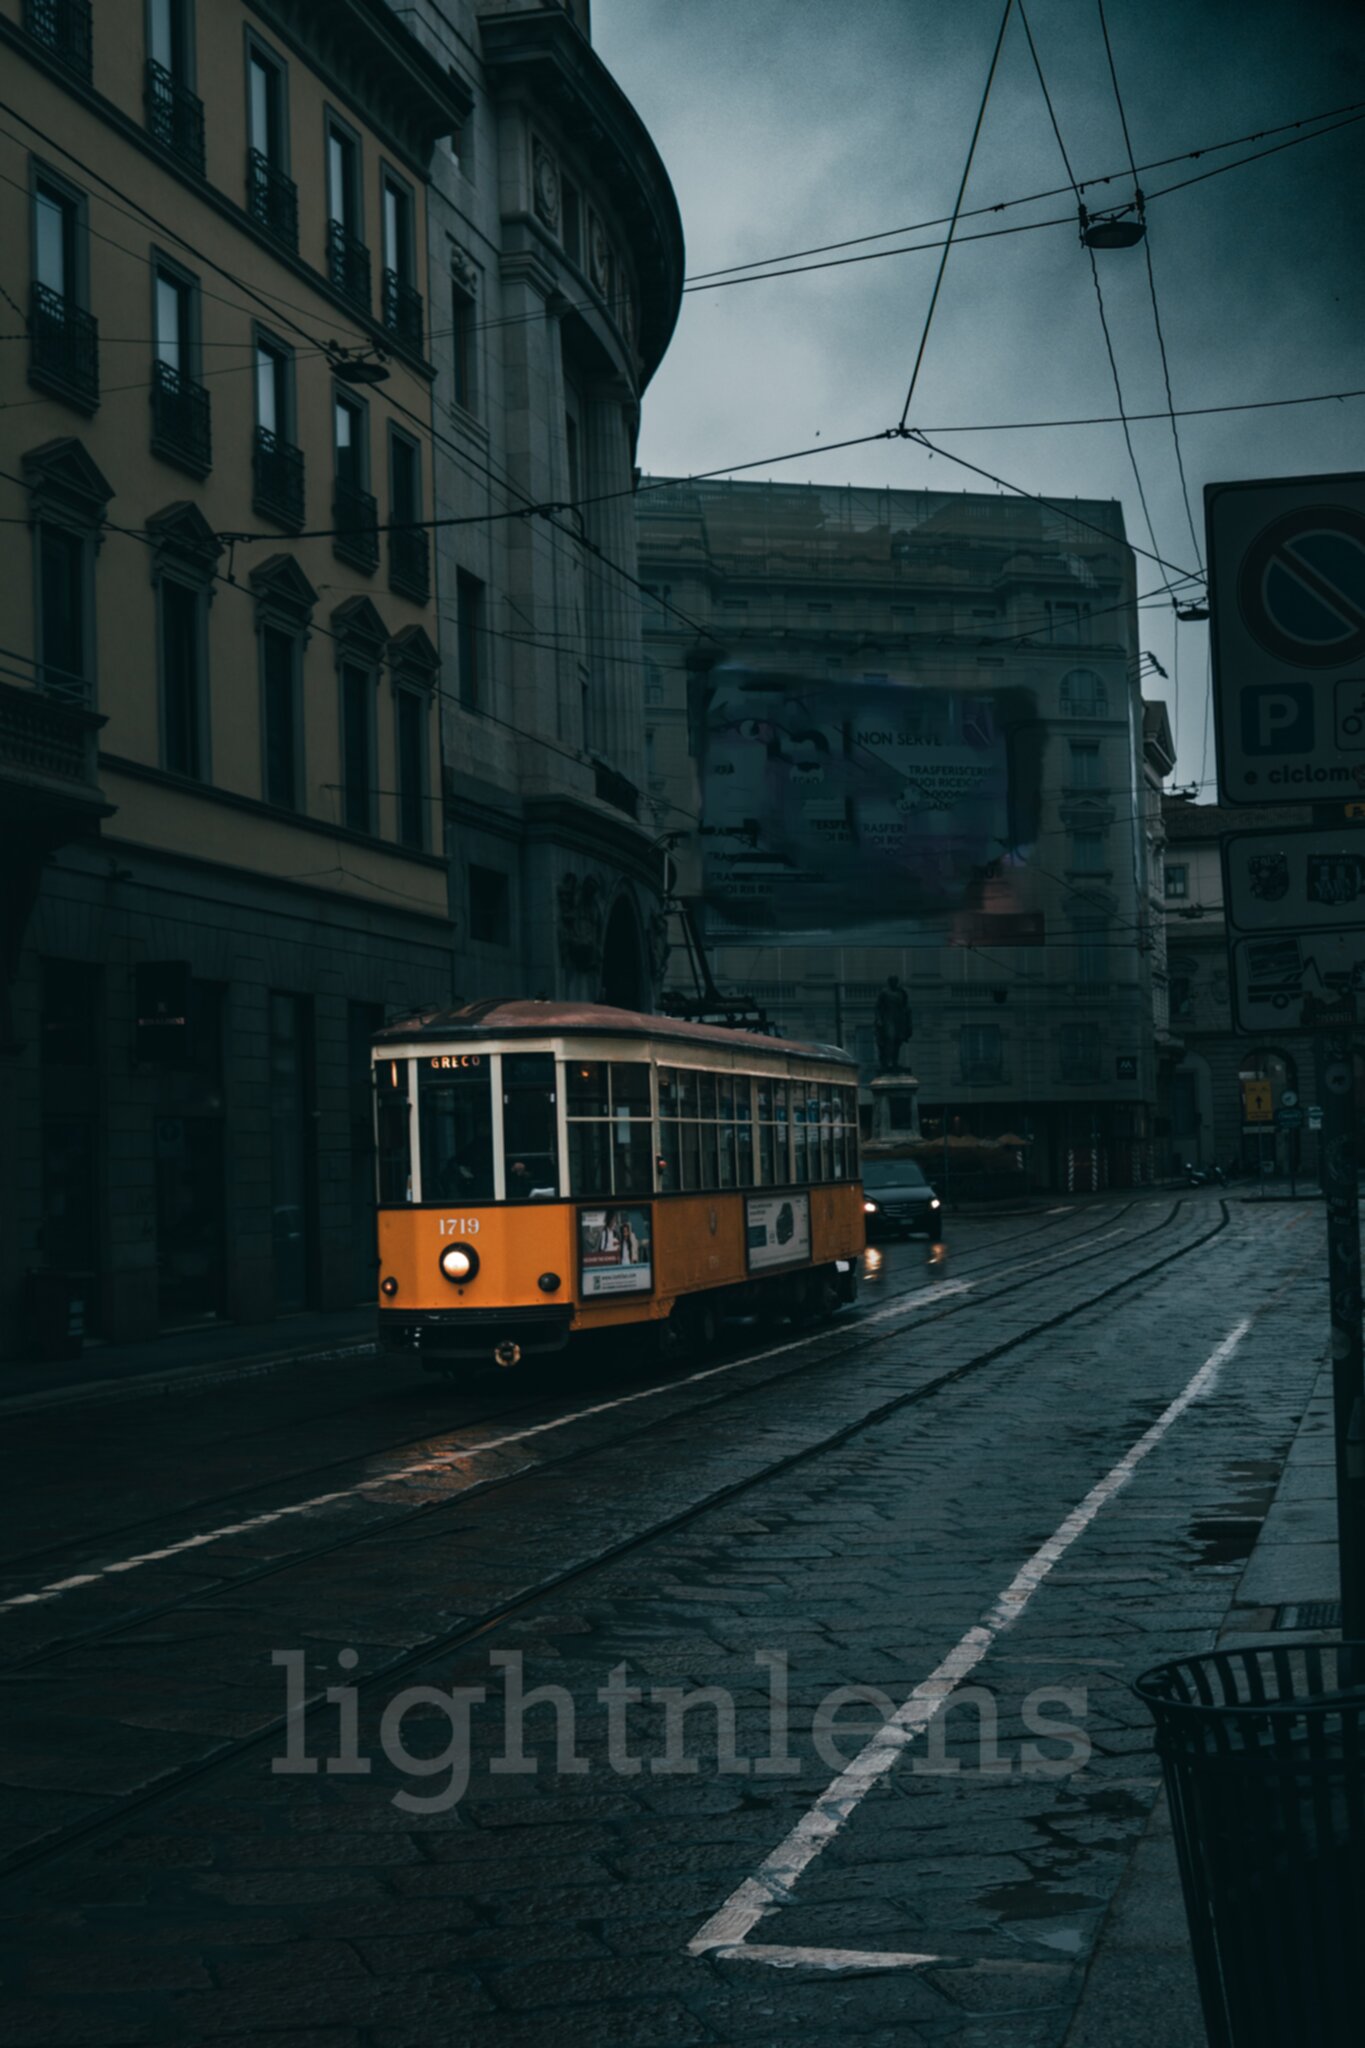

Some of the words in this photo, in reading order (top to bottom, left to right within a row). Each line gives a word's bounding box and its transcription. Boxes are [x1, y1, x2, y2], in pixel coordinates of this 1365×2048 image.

[1258, 693, 1299, 746] P
[857, 731, 893, 745] NON
[1244, 771, 1259, 785] e
[431, 1054, 481, 1069] GRECO
[439, 1217, 480, 1235] 1719
